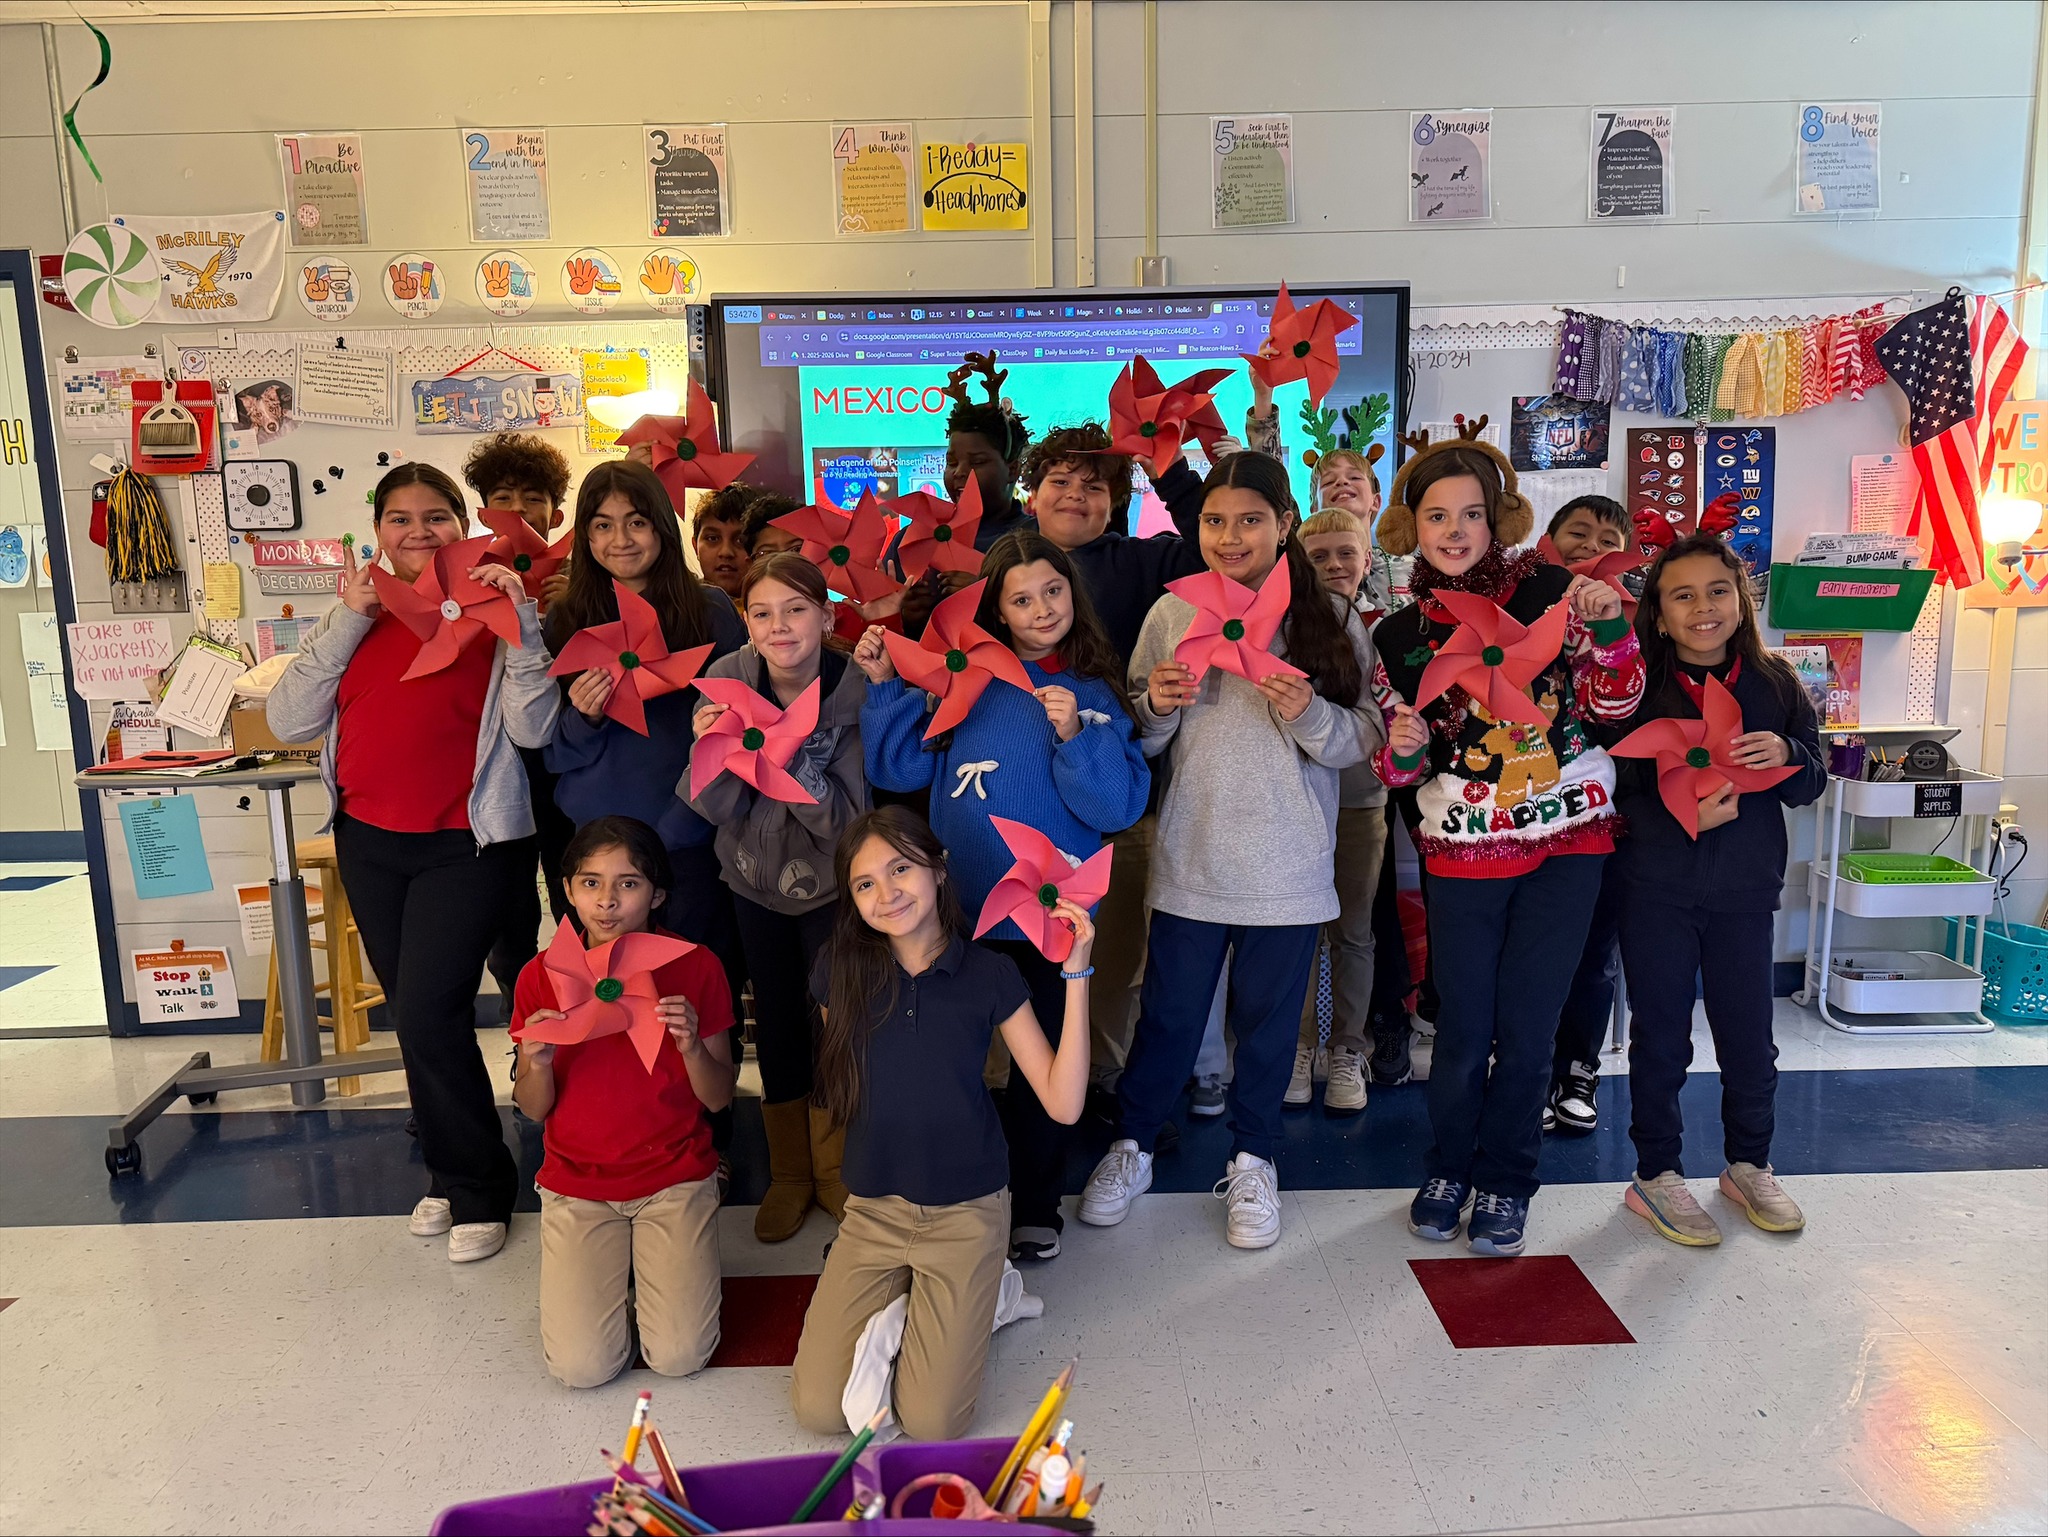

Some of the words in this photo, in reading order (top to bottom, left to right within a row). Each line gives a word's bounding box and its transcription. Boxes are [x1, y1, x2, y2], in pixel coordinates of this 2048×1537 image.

[1615, 116, 1654, 129] Sharpen
[1656, 116, 1671, 126] the
[1801, 106, 1824, 142] 8
[1825, 112, 1849, 125] Find
[1851, 113, 1879, 125] Your
[1248, 124, 1263, 132] Seek
[1414, 114, 1435, 145] 6
[1434, 120, 1490, 136] Synergize
[1598, 113, 1617, 147] 7
[1650, 128, 1669, 138] Saw
[1852, 127, 1878, 138] Voice
[517, 134, 543, 145] Begin
[684, 134, 699, 145] Put
[880, 131, 906, 142] Think
[1215, 121, 1235, 155] 5
[338, 143, 354, 157] Be
[506, 146, 527, 156] with
[529, 146, 544, 155] the
[649, 130, 669, 166] 3
[834, 128, 859, 164] 4
[868, 143, 910, 153] Win-Win
[1234, 141, 1240, 150] to
[1252, 141, 1289, 149] Understood
[283, 139, 301, 174] 1
[466, 133, 491, 170] 2
[668, 146, 699, 158] Things
[306, 160, 360, 174] Proactive
[491, 159, 508, 169] end
[511, 160, 520, 168] in
[523, 160, 546, 168] Mind
[935, 184, 1020, 214] Headphones
[228, 271, 253, 281] 1970
[170, 293, 238, 309] HAWKS
[408, 302, 428, 311] PENCIL
[500, 299, 519, 309] DRINK
[584, 297, 603, 307] TISSUE
[658, 297, 686, 306] QUESTION
[316, 304, 348, 314] BATHROOM
[728, 310, 758, 318] 534276
[866, 351, 889, 360] Google
[1002, 349, 1028, 357] ClassDojo
[1068, 348, 1089, 356] Loading
[812, 386, 946, 414] MEXICO
[418, 392, 467, 424] LET
[470, 397, 498, 421] IT
[1549, 428, 1572, 443] NFL
[1994, 413, 2040, 450] WE
[820, 459, 835, 467] The
[837, 458, 864, 467] Legend
[866, 458, 874, 466] of
[876, 458, 887, 466] the
[1568, 453, 1586, 461] Draft
[920, 465, 935, 474] the
[262, 544, 333, 561] MONDAY
[1846, 553, 1872, 564] BUMP
[1872, 550, 1898, 561] GAME
[1822, 582, 1847, 595] Early
[1850, 584, 1890, 595] Finishers
[134, 620, 154, 634] off
[102, 665, 124, 681] not
[125, 707, 155, 718] Grade
[112, 719, 161, 728] CHEDULE
[1924, 788, 1951, 798] STUDENT
[1441, 780, 1608, 834] SNAPPED
[1923, 801, 1951, 811] SUPPLIES
[153, 971, 190, 982] Stop
[155, 988, 198, 996] Walk
[160, 1003, 184, 1014] Talk
